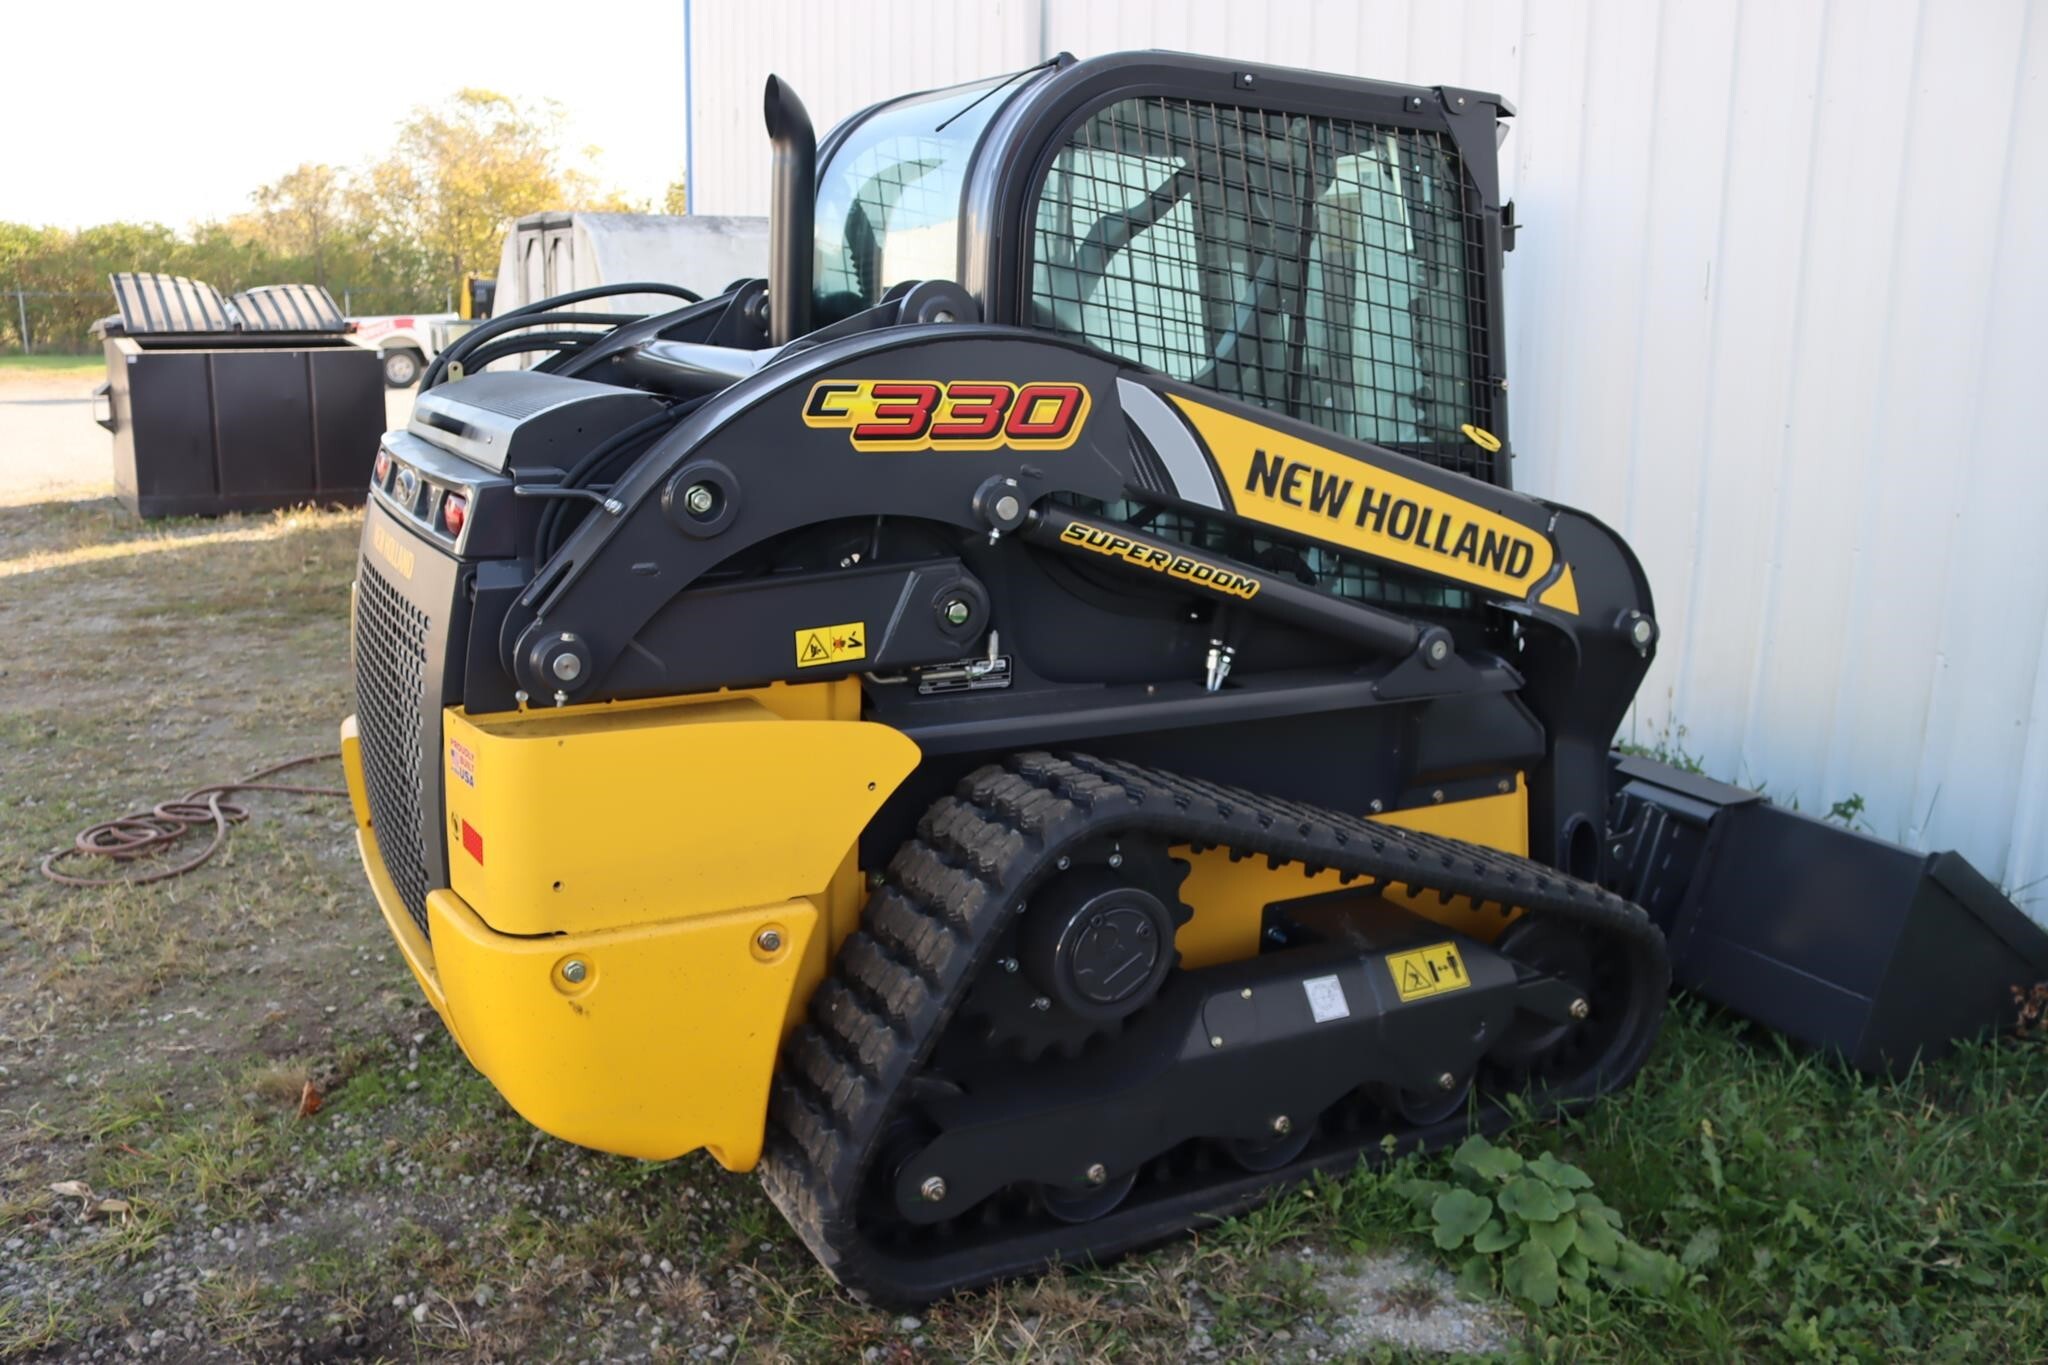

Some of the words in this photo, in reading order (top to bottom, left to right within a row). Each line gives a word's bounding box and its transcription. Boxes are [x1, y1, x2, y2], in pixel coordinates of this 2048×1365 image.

[804, 382, 1087, 443] C330
[1244, 448, 1353, 520] NEW
[1354, 485, 1534, 580] HOLLAND
[1062, 523, 1170, 568] SUPER
[1171, 556, 1258, 596] BOOM
[459, 768, 475, 788] USA
